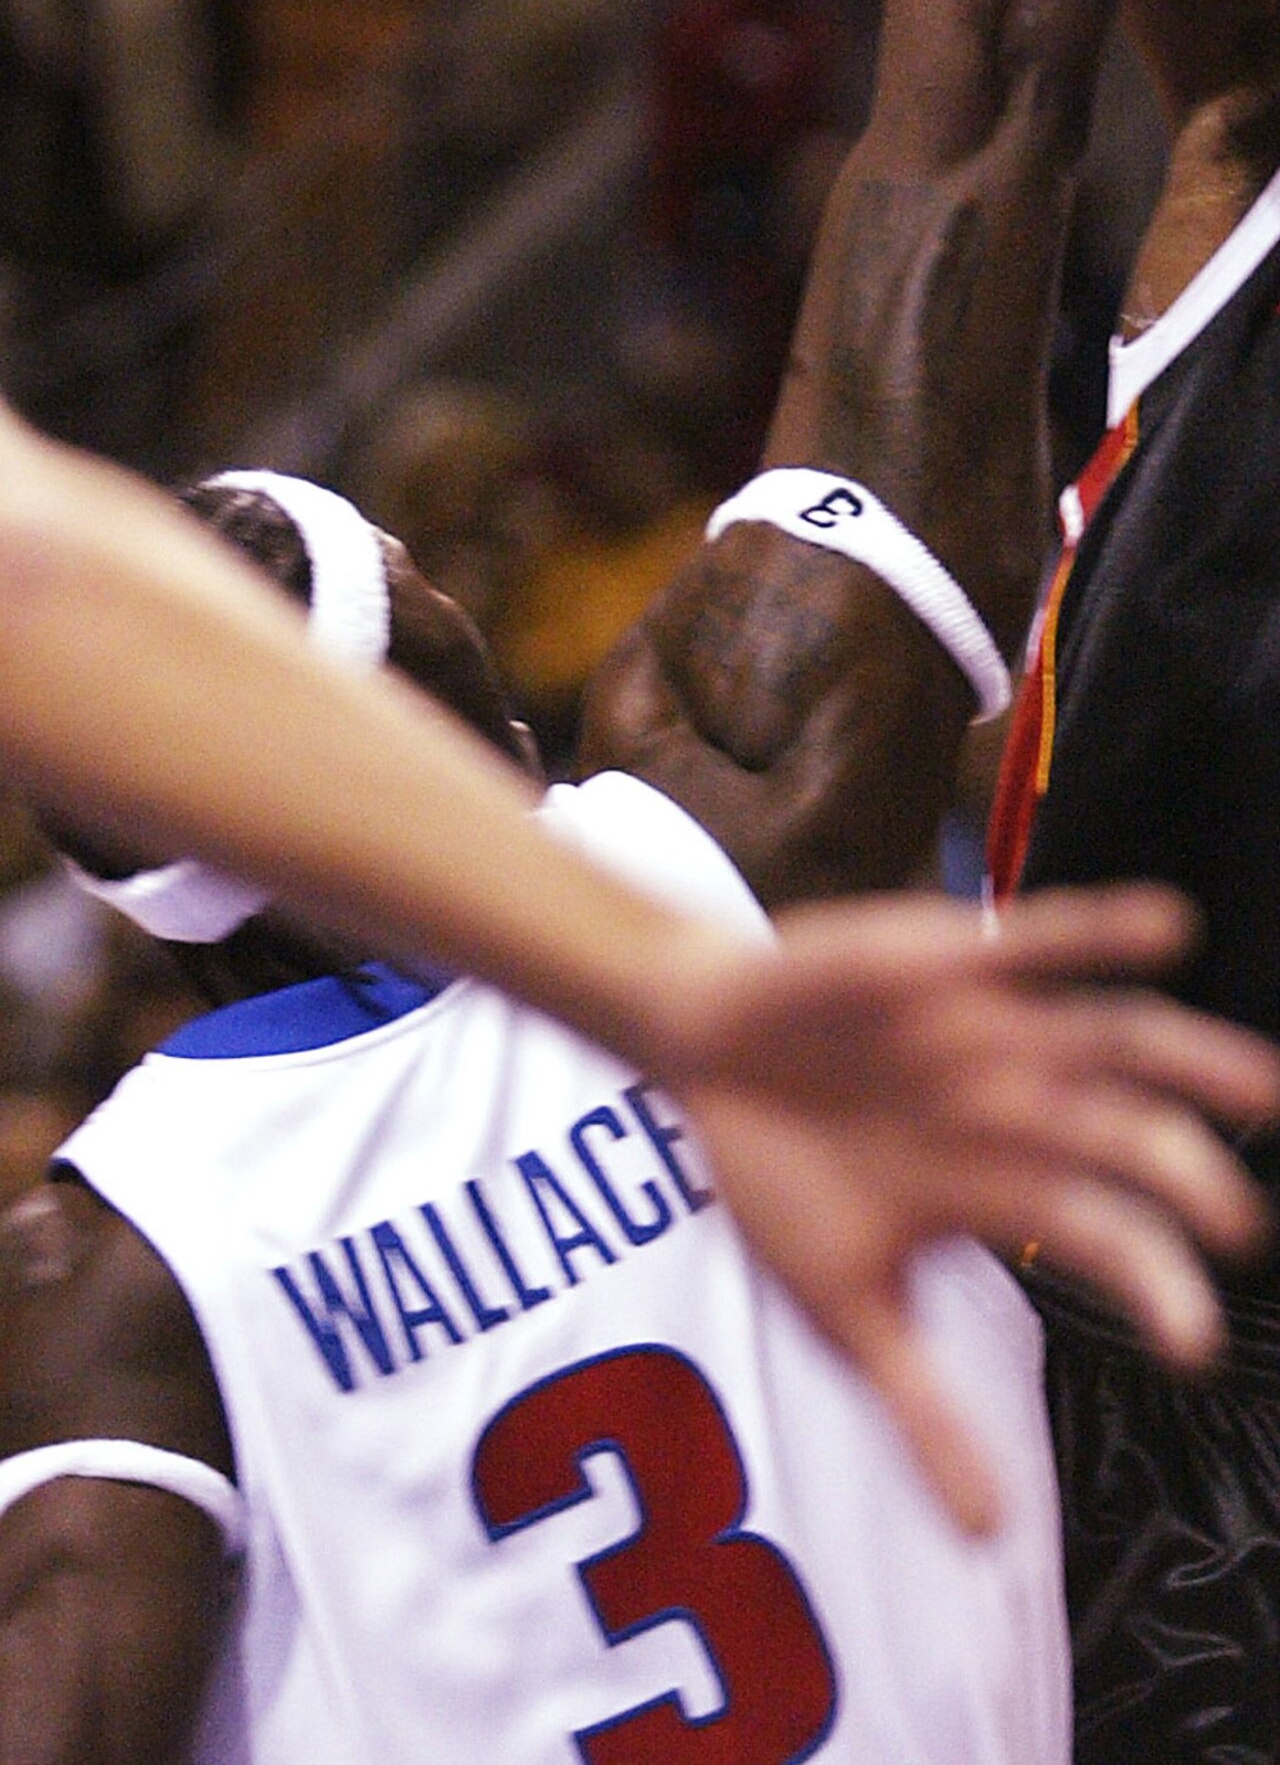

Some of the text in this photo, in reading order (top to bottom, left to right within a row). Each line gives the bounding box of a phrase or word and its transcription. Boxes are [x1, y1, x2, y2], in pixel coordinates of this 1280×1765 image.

[799, 487, 864, 528] 3
[268, 1078, 718, 1396] WALLACE
[472, 1341, 838, 1765] 3
